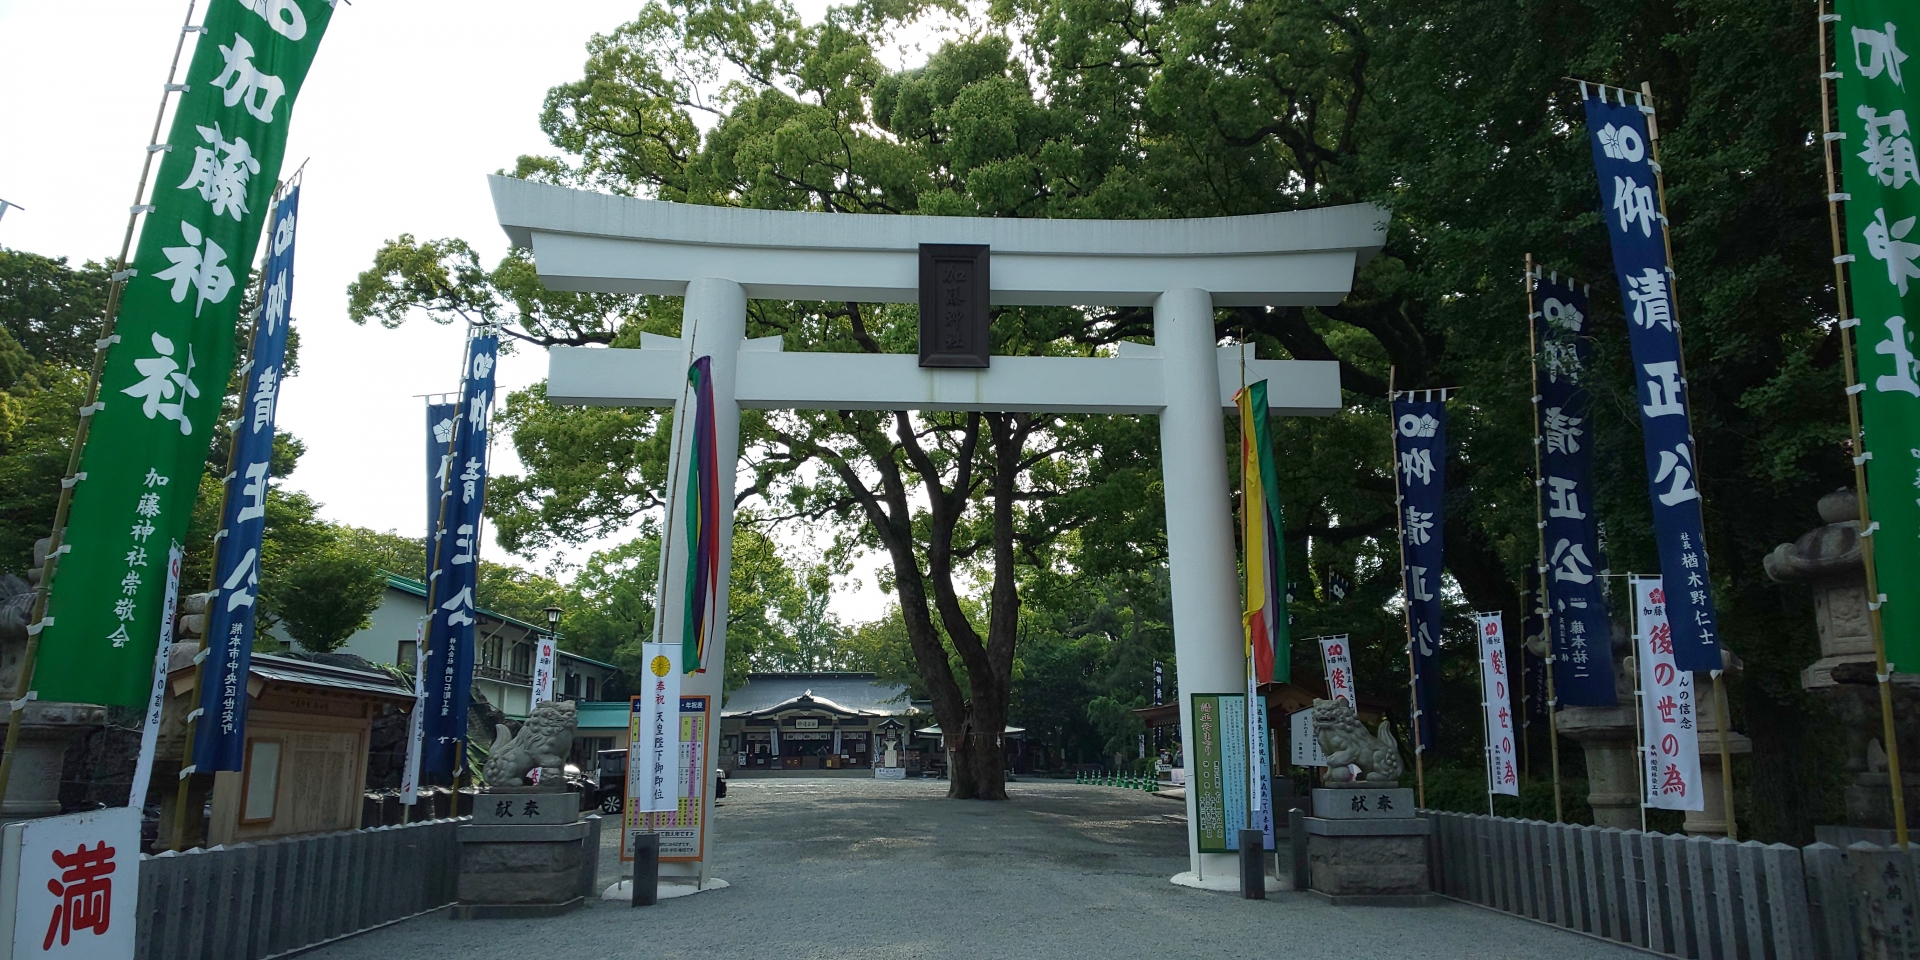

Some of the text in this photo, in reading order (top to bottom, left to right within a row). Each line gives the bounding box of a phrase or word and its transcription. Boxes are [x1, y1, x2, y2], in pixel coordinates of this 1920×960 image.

[120, 32, 285, 436] 加藤神社
[1613, 176, 1699, 507] 仰清正公
[106, 467, 169, 649] 加藤神社崇敬会
[654, 680, 666, 800] 奉祝 天皇陛下御即位
[43, 840, 116, 951] 満
